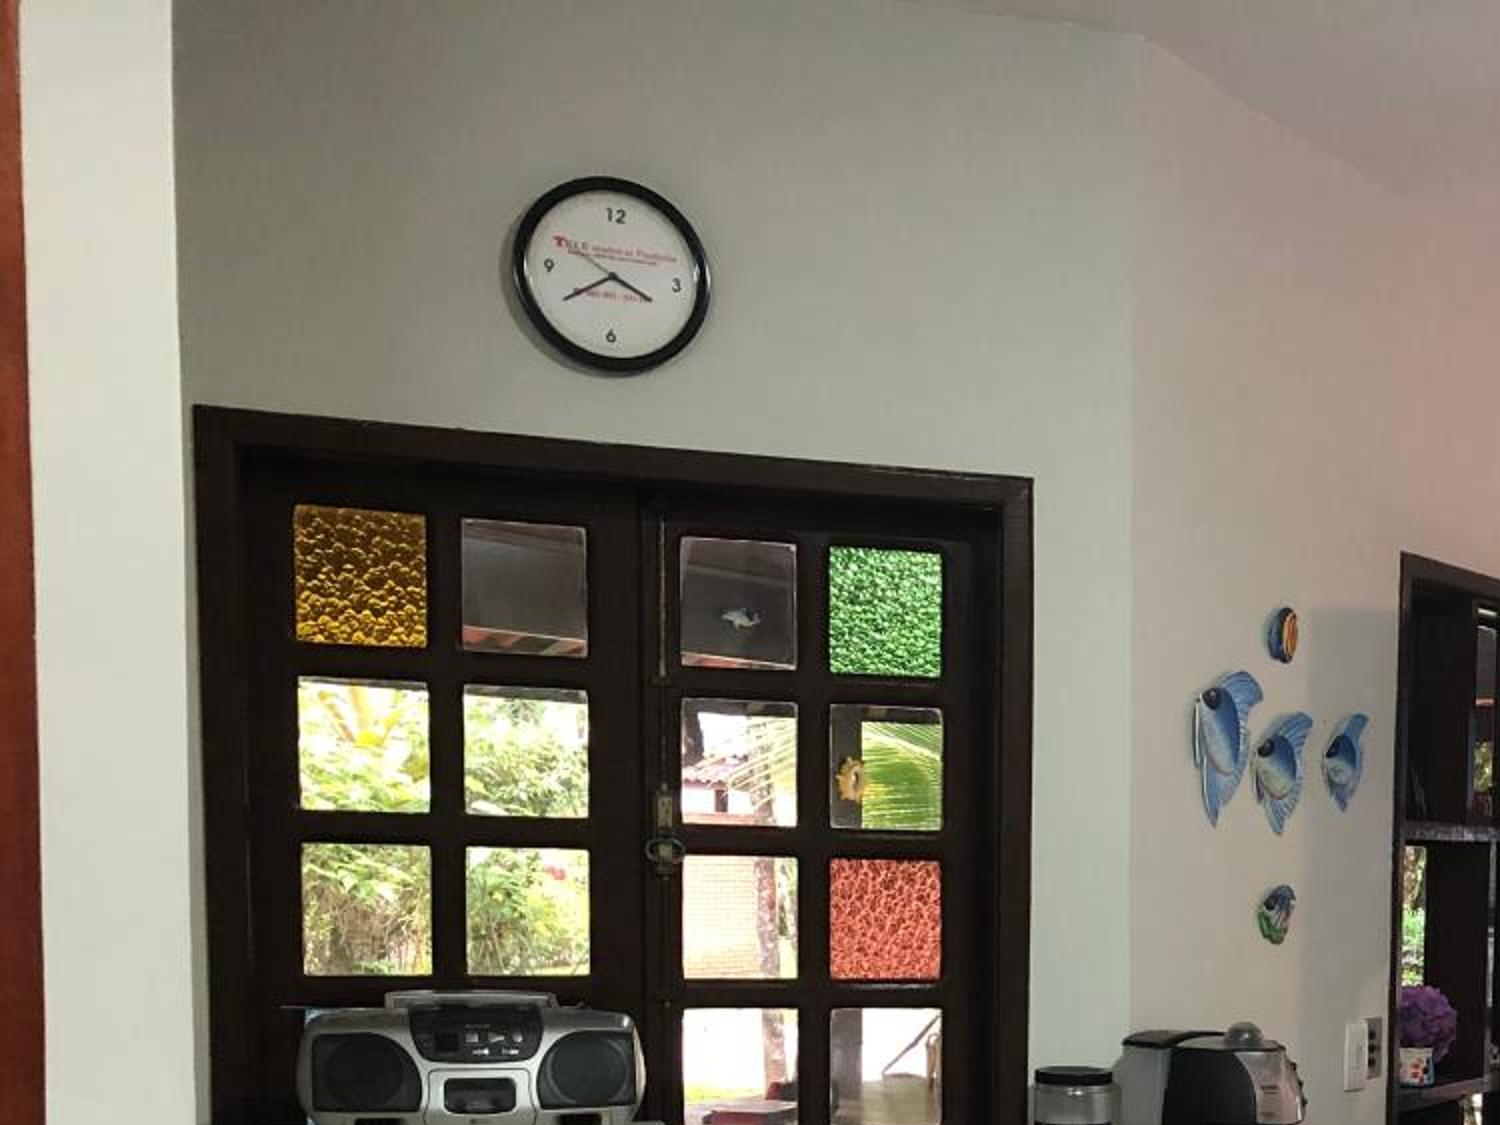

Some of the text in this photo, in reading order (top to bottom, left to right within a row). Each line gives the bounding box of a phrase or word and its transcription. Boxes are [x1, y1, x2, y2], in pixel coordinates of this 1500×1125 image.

[606, 207, 626, 225] 12
[543, 258, 555, 273] 9
[671, 278, 682, 293] 3
[605, 328, 617, 343] 6
